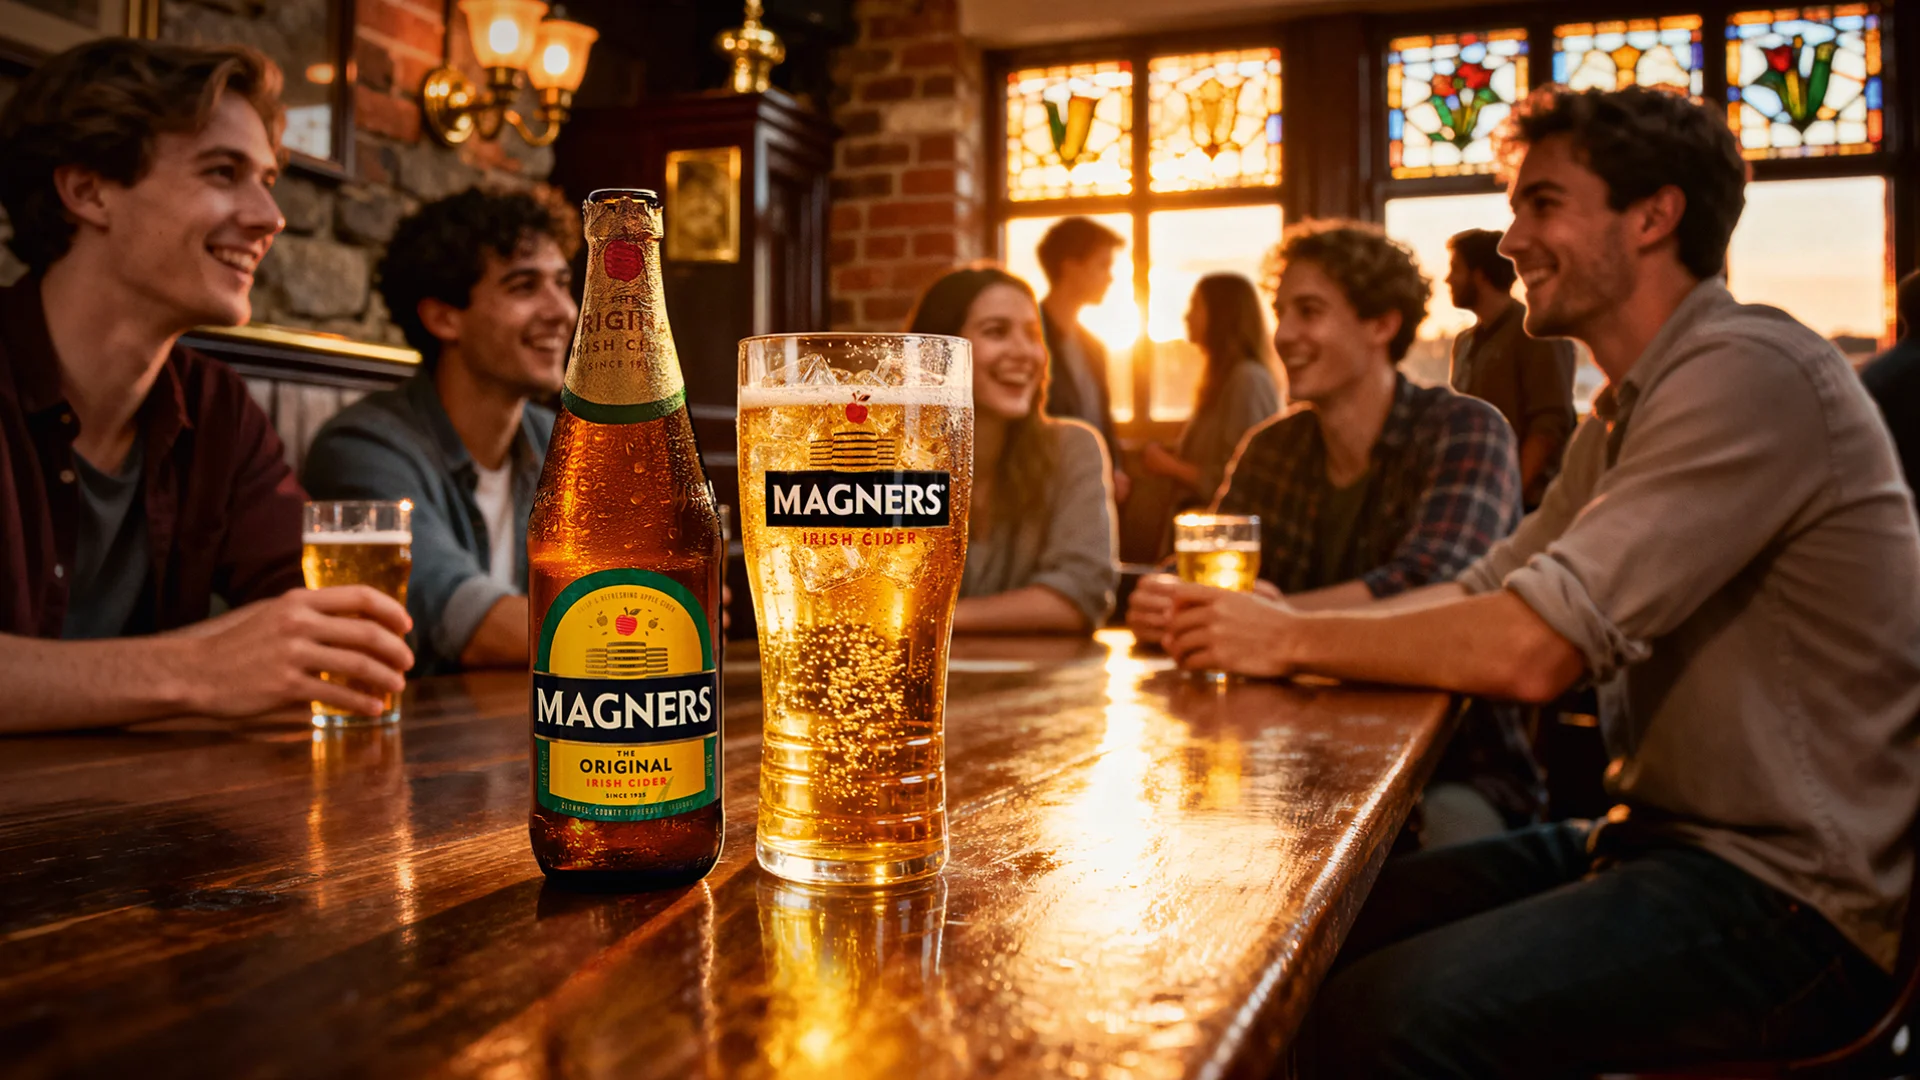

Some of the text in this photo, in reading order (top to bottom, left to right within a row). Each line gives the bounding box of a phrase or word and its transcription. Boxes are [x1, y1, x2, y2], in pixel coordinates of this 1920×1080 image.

[588, 360, 622, 371] SINCE
[803, 531, 916, 545] IRISH CIDER
[640, 593, 658, 604] APPLE
[536, 686, 712, 730] MAGNERS
[579, 757, 672, 774] ORIGINAL
[586, 776, 667, 788] IRISH CIDER
[595, 808, 621, 816] COUNTY
